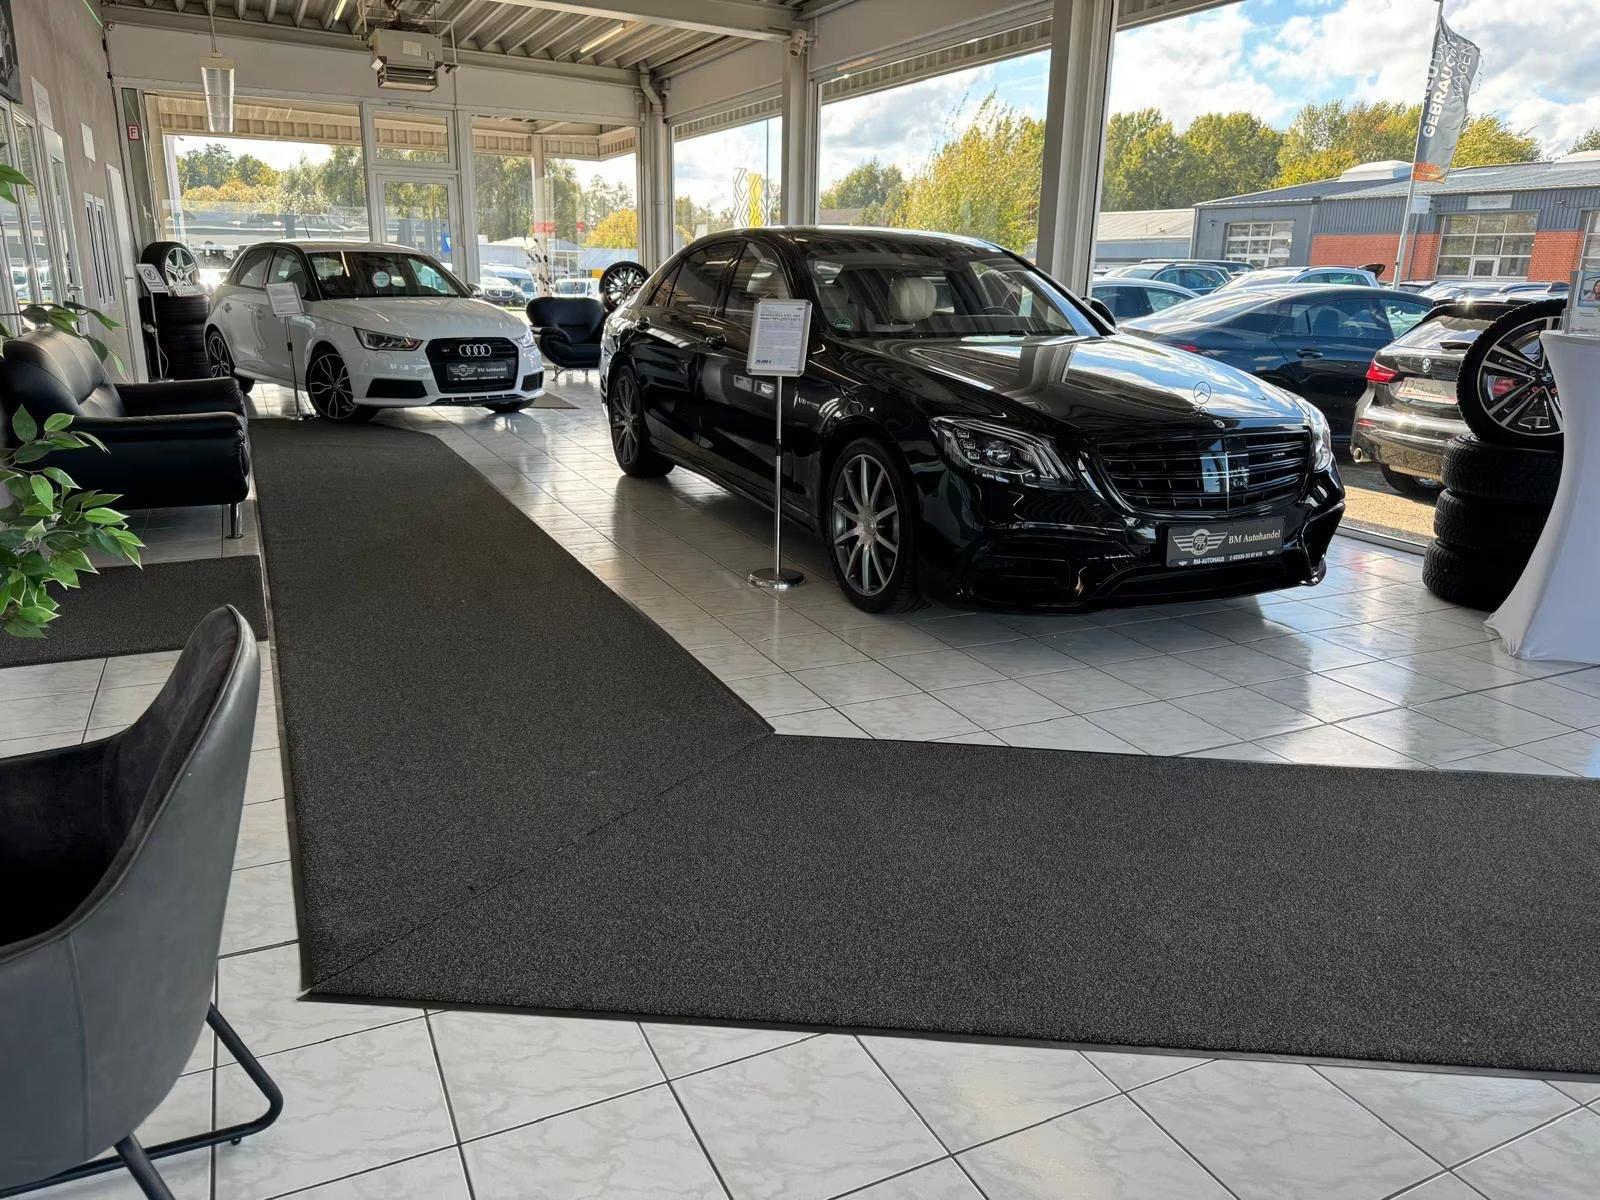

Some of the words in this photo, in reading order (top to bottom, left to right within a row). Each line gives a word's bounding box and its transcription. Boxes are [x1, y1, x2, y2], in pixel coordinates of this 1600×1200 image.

[1451, 44, 1474, 102] WAGEN
[1228, 535, 1242, 545] BM
[1243, 529, 1281, 543] Autohandel
